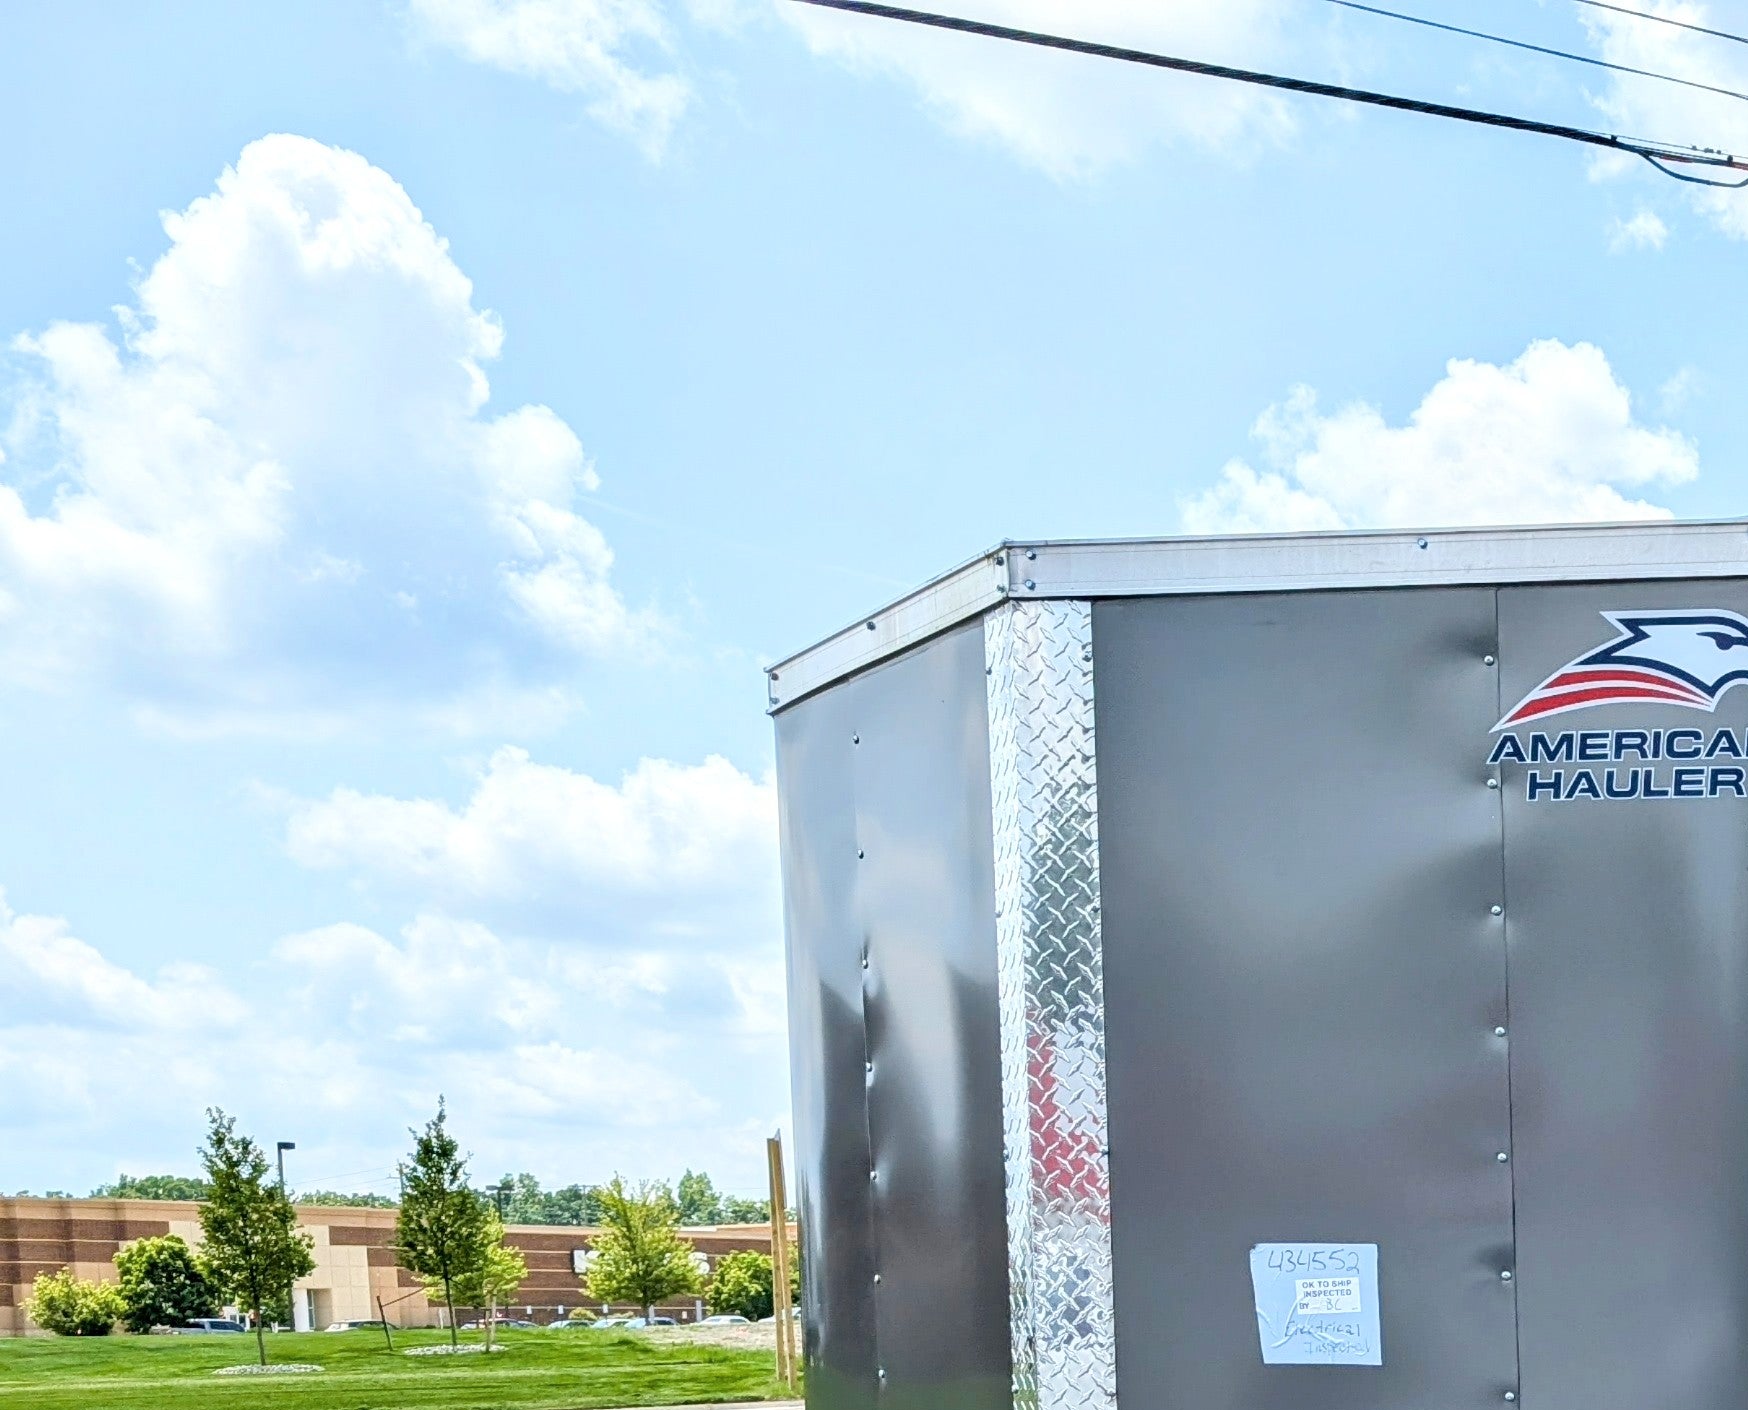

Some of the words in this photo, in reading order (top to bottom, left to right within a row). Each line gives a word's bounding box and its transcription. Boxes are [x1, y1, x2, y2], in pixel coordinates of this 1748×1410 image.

[1526, 766, 1748, 802] HAULER
[1267, 1249, 1360, 1274] 434552
[1302, 1281, 1315, 1289] OK
[1318, 1280, 1330, 1288] TO
[1304, 1289, 1352, 1298] INSPECTED
[1299, 1302, 1310, 1310] BY
